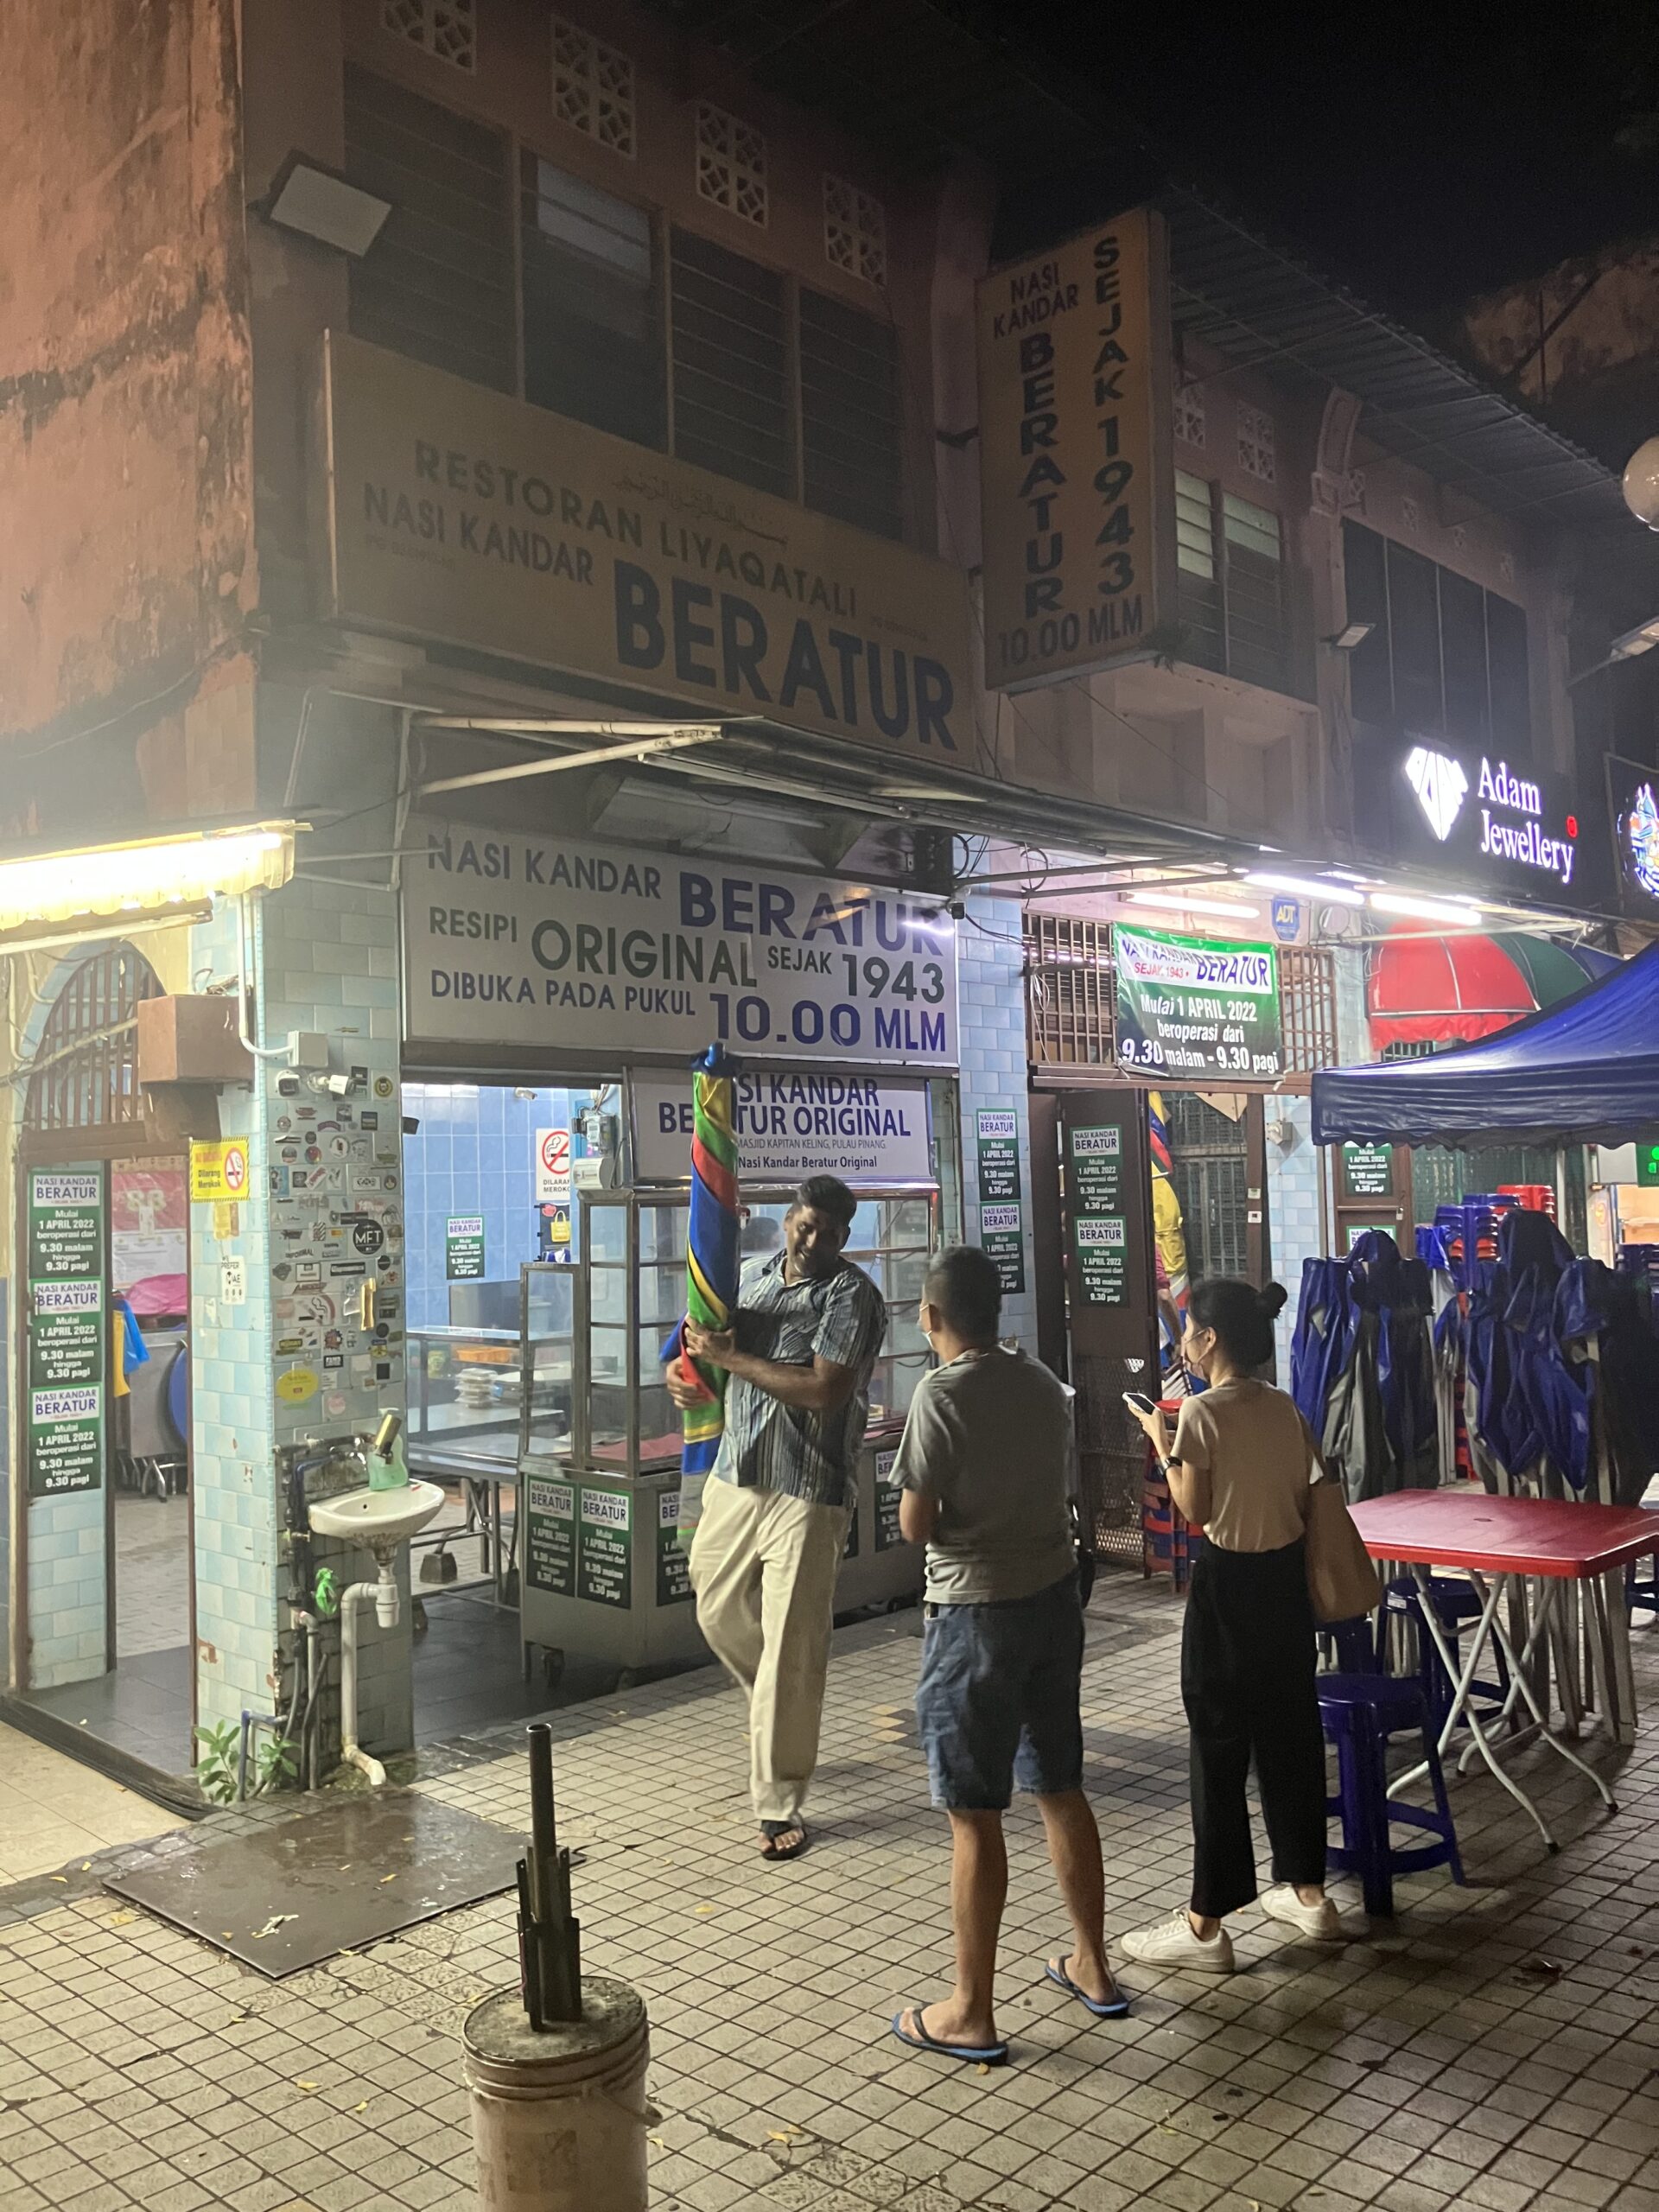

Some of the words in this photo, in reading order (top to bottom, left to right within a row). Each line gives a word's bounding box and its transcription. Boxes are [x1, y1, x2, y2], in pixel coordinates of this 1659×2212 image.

[1010, 262, 1060, 302] NASI
[994, 283, 1078, 340] KANDAR
[1092, 236, 1129, 407] SEJAK
[1018, 332, 1066, 619] BERATUR
[1093, 416, 1135, 595] 1943
[416, 439, 642, 548] RESTORAN
[660, 522, 856, 617] LIYAQATALI
[364, 482, 445, 543] NASI
[460, 511, 594, 586] KANDAR
[613, 558, 958, 751] BERATUR
[998, 612, 1079, 668] 10.00
[1089, 594, 1142, 644] MLM
[1478, 757, 1541, 815] Adam
[1481, 810, 1573, 884] Jewellery
[428, 834, 510, 880] NASI
[525, 849, 661, 899] KANDAR
[680, 871, 944, 957] BERATUR
[1275, 905, 1295, 924] ADT
[429, 906, 517, 943] RESIPI
[531, 919, 757, 988] ORIGINAL
[768, 945, 832, 975] SEJAK
[842, 954, 944, 1004] 1943
[1166, 967, 1184, 978] 1943
[1197, 954, 1268, 986] BERATUR
[432, 969, 536, 1004] DIBUKA
[546, 979, 616, 1010] PADA
[625, 986, 696, 1016] PUKUL
[709, 993, 861, 1046] 10.00
[874, 1007, 946, 1052] MLM
[1141, 995, 1174, 1015] Mulai
[1178, 997, 1184, 1016] 1
[1188, 997, 1226, 1020] APRIL
[1227, 1001, 1257, 1022] 2022
[1157, 1019, 1218, 1043] beroperasi
[1223, 1025, 1244, 1043] dari
[1122, 1039, 1163, 1065] 9.30
[1164, 1047, 1205, 1067] malam
[1216, 1046, 1250, 1070] 9.30
[1253, 1052, 1279, 1074] pagi
[738, 1072, 762, 1103] SI
[771, 1076, 879, 1107] KANDAR
[658, 1103, 787, 1135] BETUR
[793, 1108, 912, 1136] ORIGINAL
[981, 1122, 1014, 1132] BERATUR
[767, 1139, 800, 1149] KAPITAN
[832, 1139, 860, 1149] PULAU
[1076, 1139, 1116, 1149] BERATUR
[738, 1156, 760, 1168] Nasi
[763, 1156, 800, 1168] Kandar
[802, 1156, 837, 1168] Beratur
[840, 1156, 878, 1170] Original
[36, 1187, 96, 1198] BERATUR
[39, 1220, 43, 1229] 1
[47, 1220, 71, 1229] APRIL
[73, 1219, 94, 1228] 2022
[984, 1215, 1017, 1226] BERATUR
[355, 1230, 381, 1243] MFT
[1080, 1230, 1121, 1239] BERATUR
[40, 1243, 62, 1252] 9.30
[46, 1262, 68, 1271] 9.30
[38, 1293, 97, 1306] BERATUR
[56, 1316, 79, 1325] Mulai
[40, 1328, 44, 1337] 1
[48, 1326, 72, 1337] APRIL
[73, 1325, 95, 1335] 2022
[82, 1335, 97, 1344] dari
[41, 1351, 63, 1360] 9.30
[48, 1369, 69, 1378] 9.30
[60, 1389, 96, 1400] KANDAR
[36, 1399, 96, 1414] BERATUR
[55, 1423, 79, 1433] Mulai
[39, 1437, 43, 1446] 1
[46, 1434, 71, 1445] APRIL
[73, 1432, 94, 1442] 2022
[40, 1459, 62, 1470] 9.30
[46, 1477, 68, 1487] 9.30
[532, 1484, 545, 1492] NASI
[547, 1486, 571, 1497] KANDAR
[532, 1493, 571, 1511] BERATUR
[583, 1491, 598, 1501] NASI
[600, 1494, 626, 1507] KANDAR
[583, 1502, 626, 1521] BERATUR
